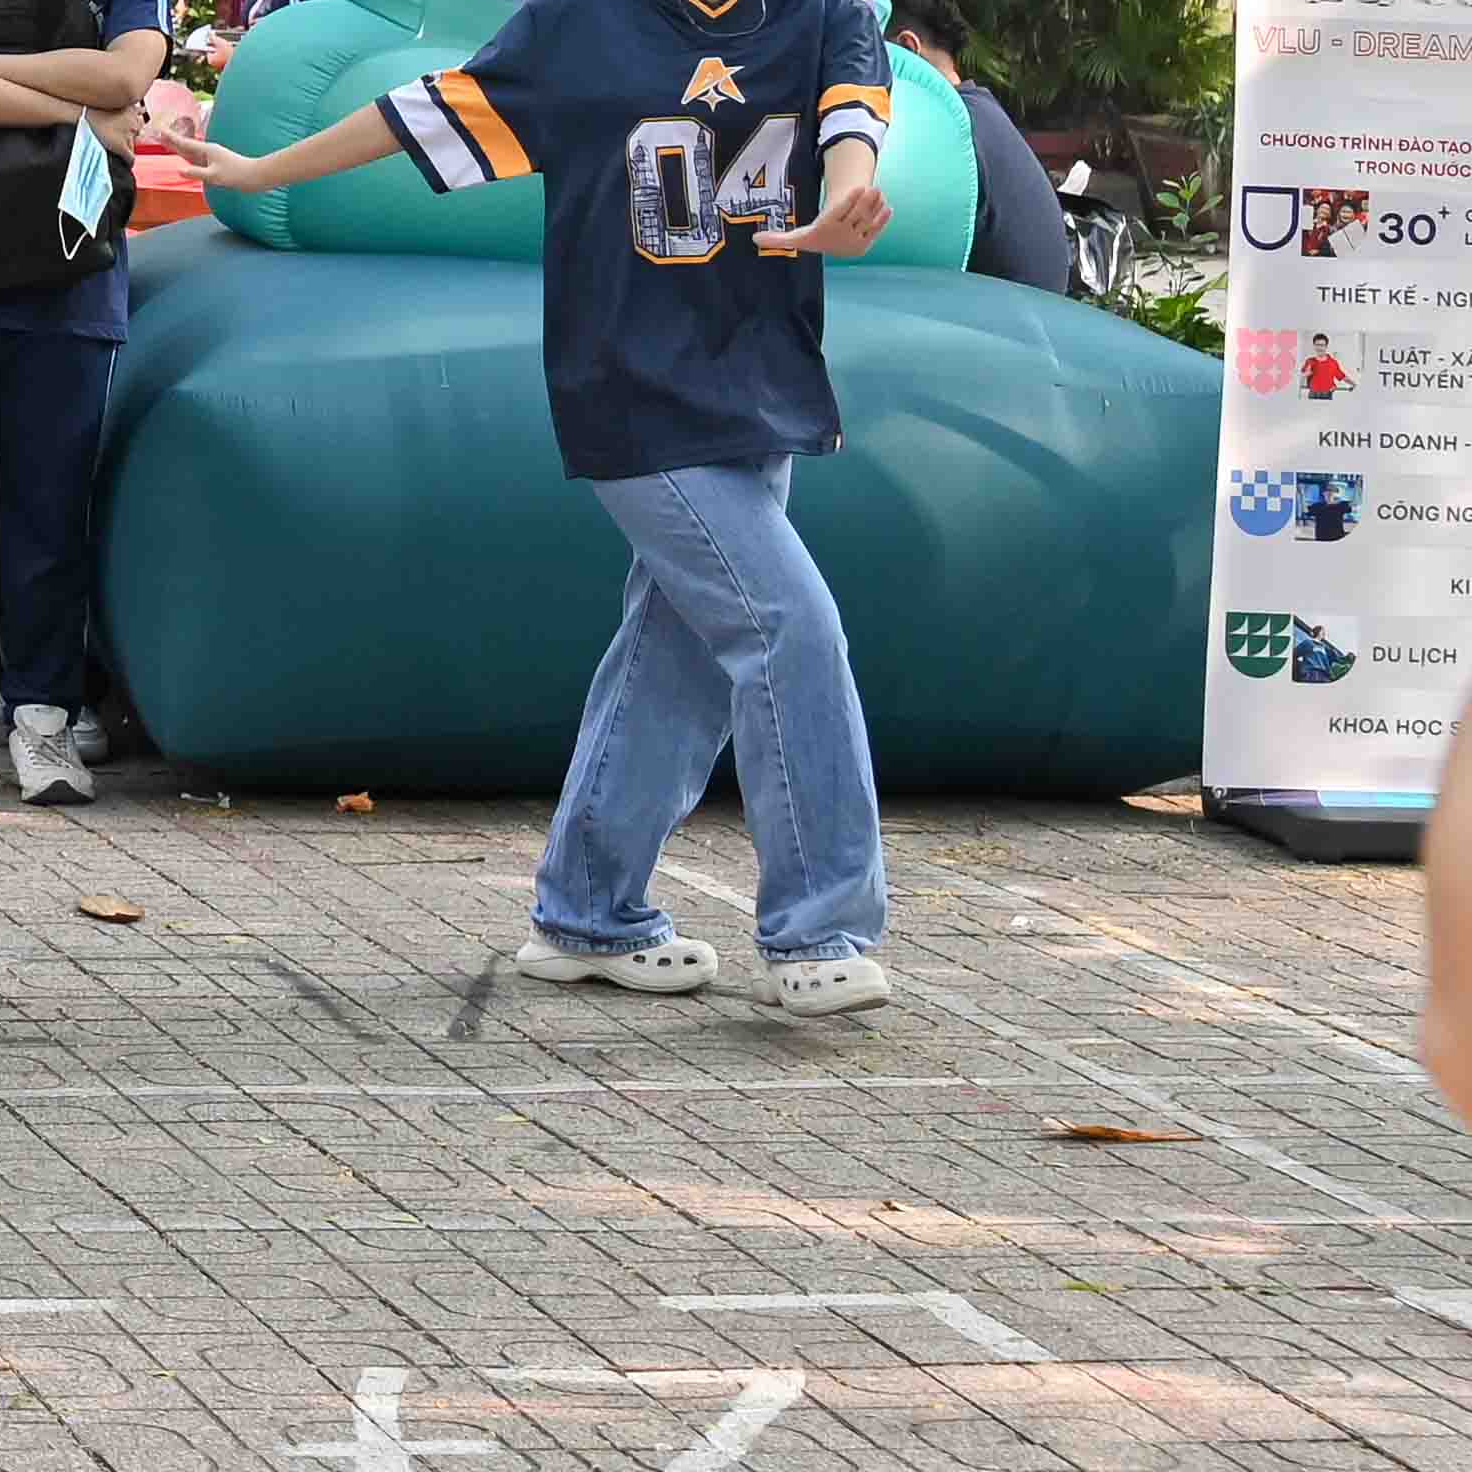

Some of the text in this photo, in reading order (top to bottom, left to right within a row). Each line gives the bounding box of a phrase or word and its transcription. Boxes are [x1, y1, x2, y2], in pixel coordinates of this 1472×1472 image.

[1253, 26, 1321, 56] VLU
[1259, 132, 1337, 150] CHƯƠNG
[1339, 132, 1394, 153] TRÌNH
[1397, 135, 1436, 155] ĐÀO
[1354, 159, 1417, 177] TRONG
[626, 113, 801, 265] 04
[1317, 282, 1382, 305] THIẾT
[1388, 284, 1418, 306] KẾ
[1379, 345, 1432, 368] LUẬT
[1318, 431, 1372, 450] KINH
[1379, 432, 1458, 452] DOANH
[1376, 499, 1440, 523] CÔNG
[1372, 645, 1458, 669] DU LỊCH
[1328, 717, 1390, 734] KHOA
[1395, 719, 1443, 741] HỌC
